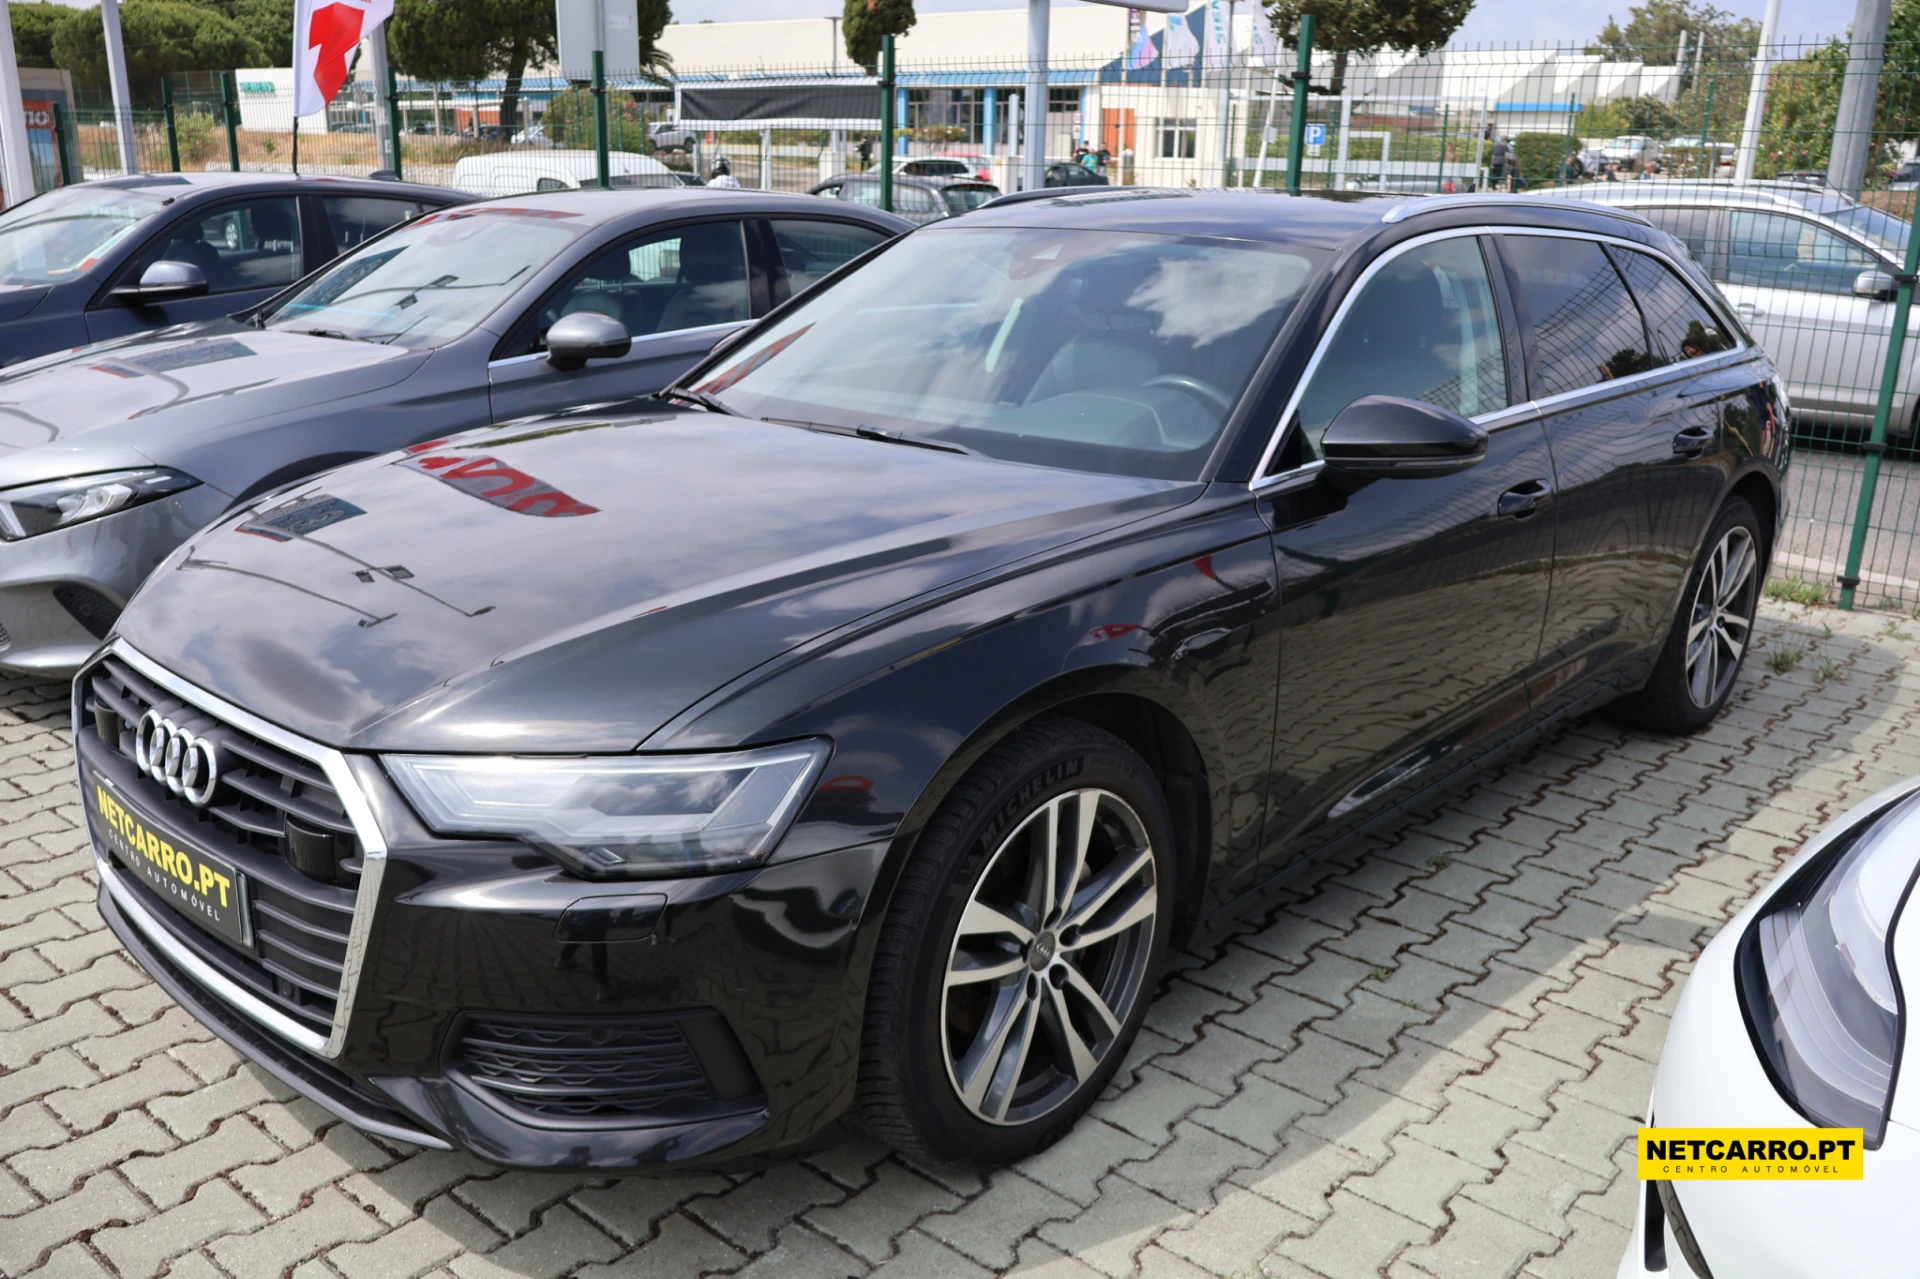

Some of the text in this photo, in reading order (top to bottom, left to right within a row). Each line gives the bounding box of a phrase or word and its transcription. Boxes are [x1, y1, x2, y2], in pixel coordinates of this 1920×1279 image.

[1308, 125, 1321, 143] P
[97, 785, 231, 908] NETCARRO.PT
[980, 757, 1078, 850] MICHELIN
[108, 828, 221, 922] CENTRO AUTOMÓVEL
